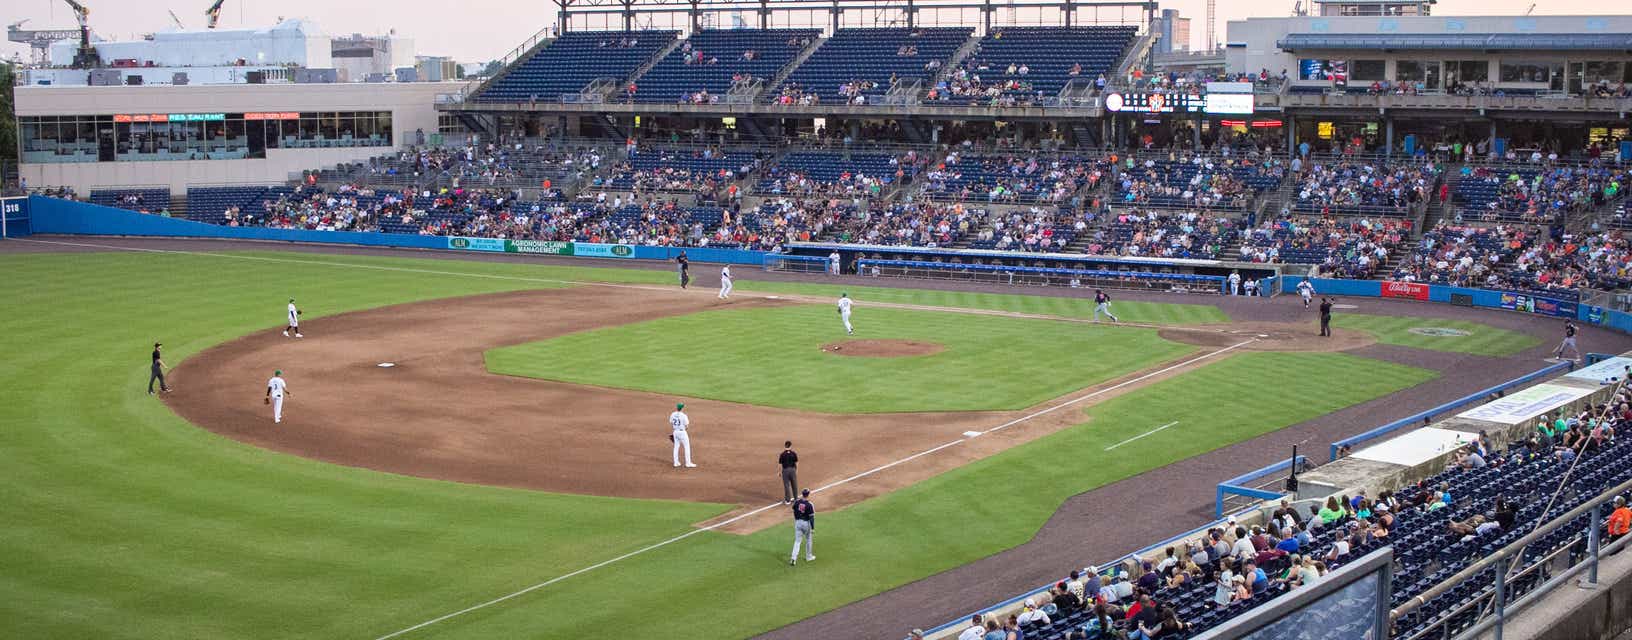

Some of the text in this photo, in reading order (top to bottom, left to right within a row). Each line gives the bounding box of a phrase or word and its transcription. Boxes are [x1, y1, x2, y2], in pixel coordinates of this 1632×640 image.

[169, 113, 225, 121] RESTAURANT
[6, 204, 19, 212] 318
[511, 240, 567, 249] AGRONOMIC LAWN
[517, 246, 560, 254] MANAGEMENT
